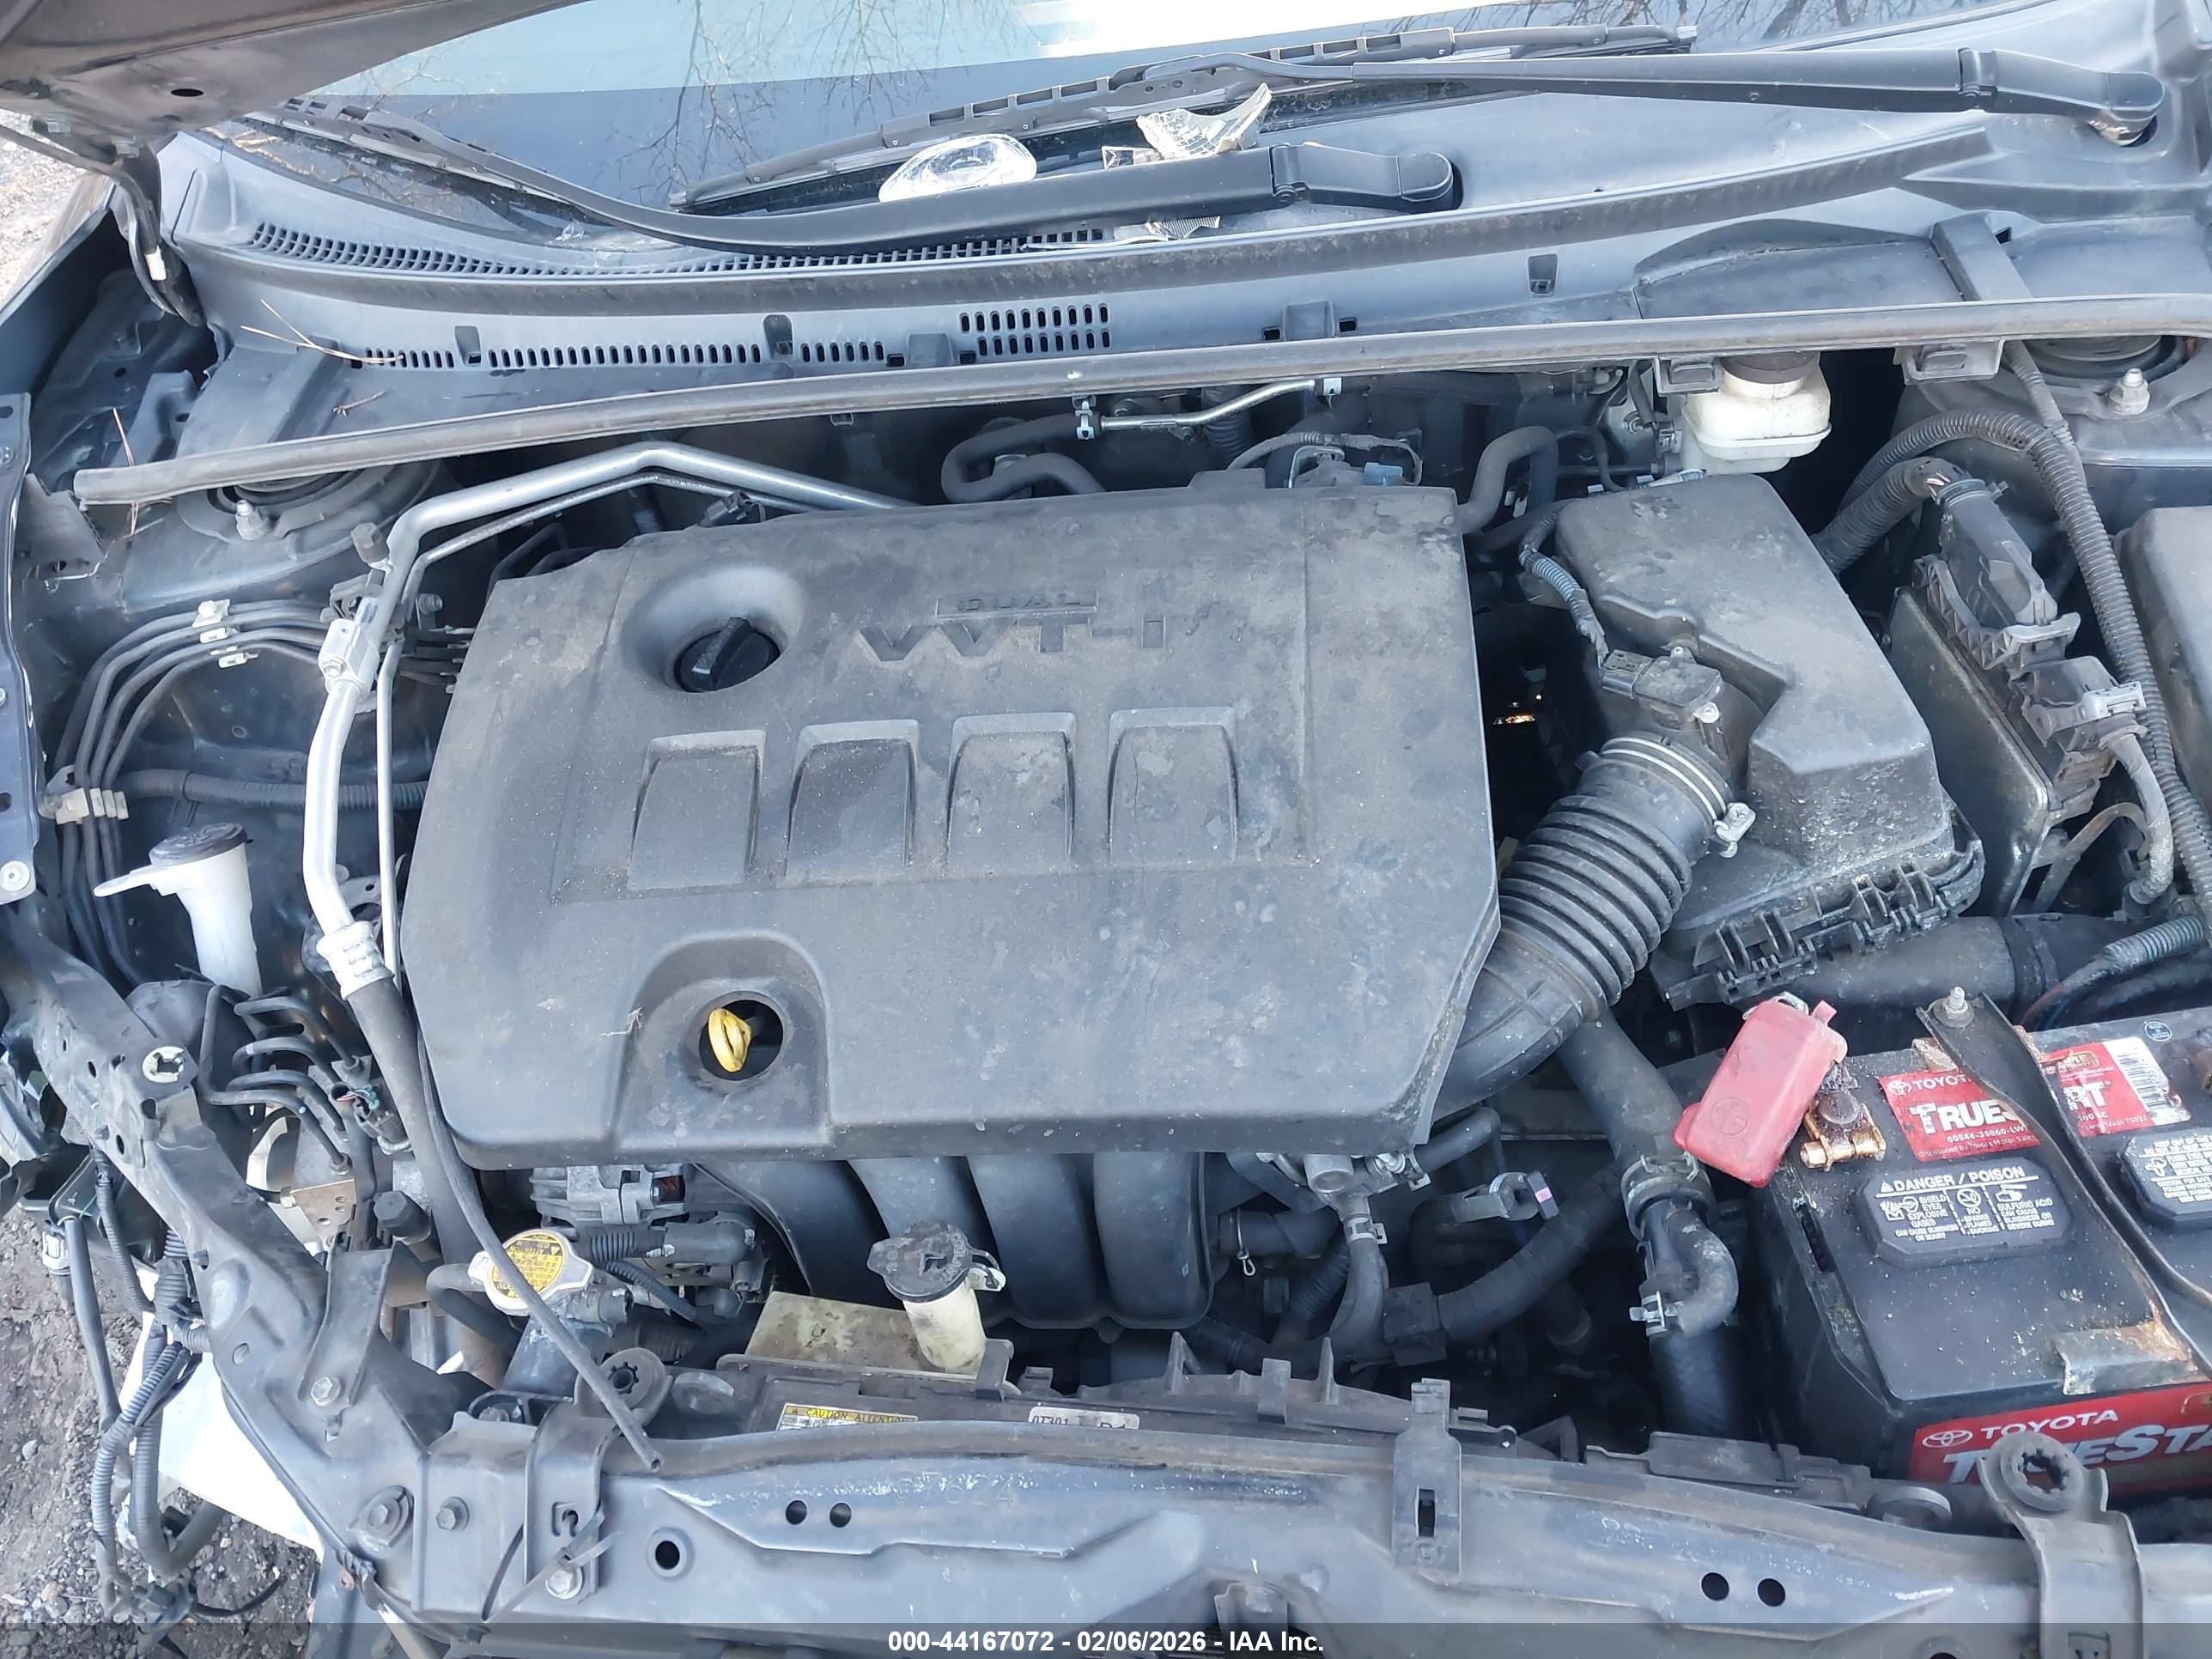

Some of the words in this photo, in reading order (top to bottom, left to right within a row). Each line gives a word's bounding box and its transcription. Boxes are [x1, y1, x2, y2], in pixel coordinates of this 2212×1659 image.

[1911, 1074, 1971, 1091] TOYOT
[1893, 1174, 1955, 1192] DANGER
[1968, 1166, 2025, 1182] POISON
[1919, 1195, 1947, 1205] SHIELD
[1922, 1203, 1942, 1212] EYES
[1966, 1206, 1981, 1215] NO
[1907, 1209, 1948, 1221] EXPLOSIVE
[806, 1407, 848, 1420] CAUTION
[1979, 1409, 2119, 1440] TOYOTA
